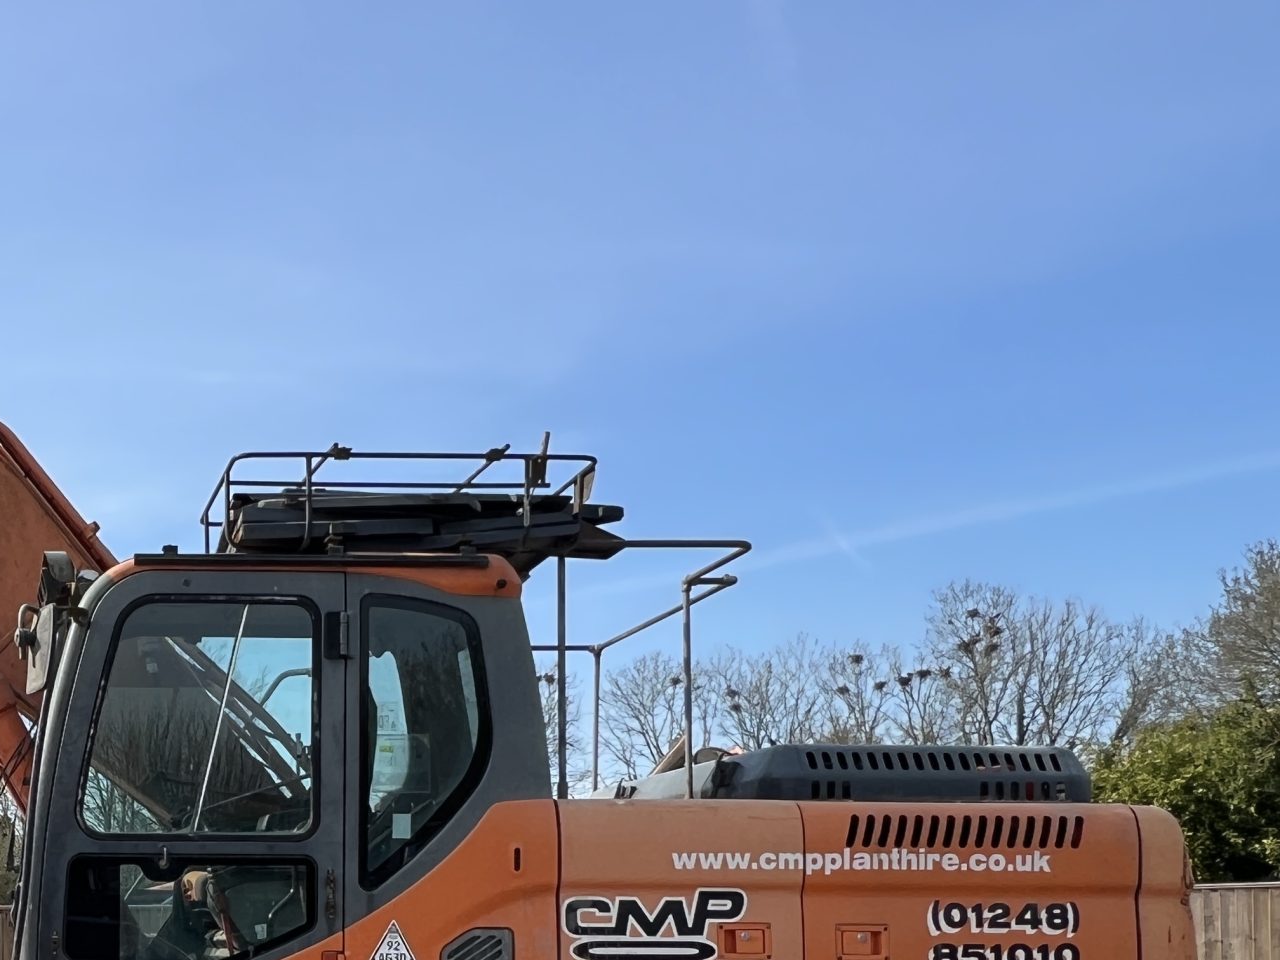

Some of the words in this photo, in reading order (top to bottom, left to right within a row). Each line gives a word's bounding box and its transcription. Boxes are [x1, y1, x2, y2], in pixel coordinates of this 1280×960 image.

[671, 848, 1052, 874] www.cmpplanthire.co.uk
[562, 887, 747, 938] CMP
[927, 900, 1080, 937] (01248)
[386, 940, 401, 951] 92
